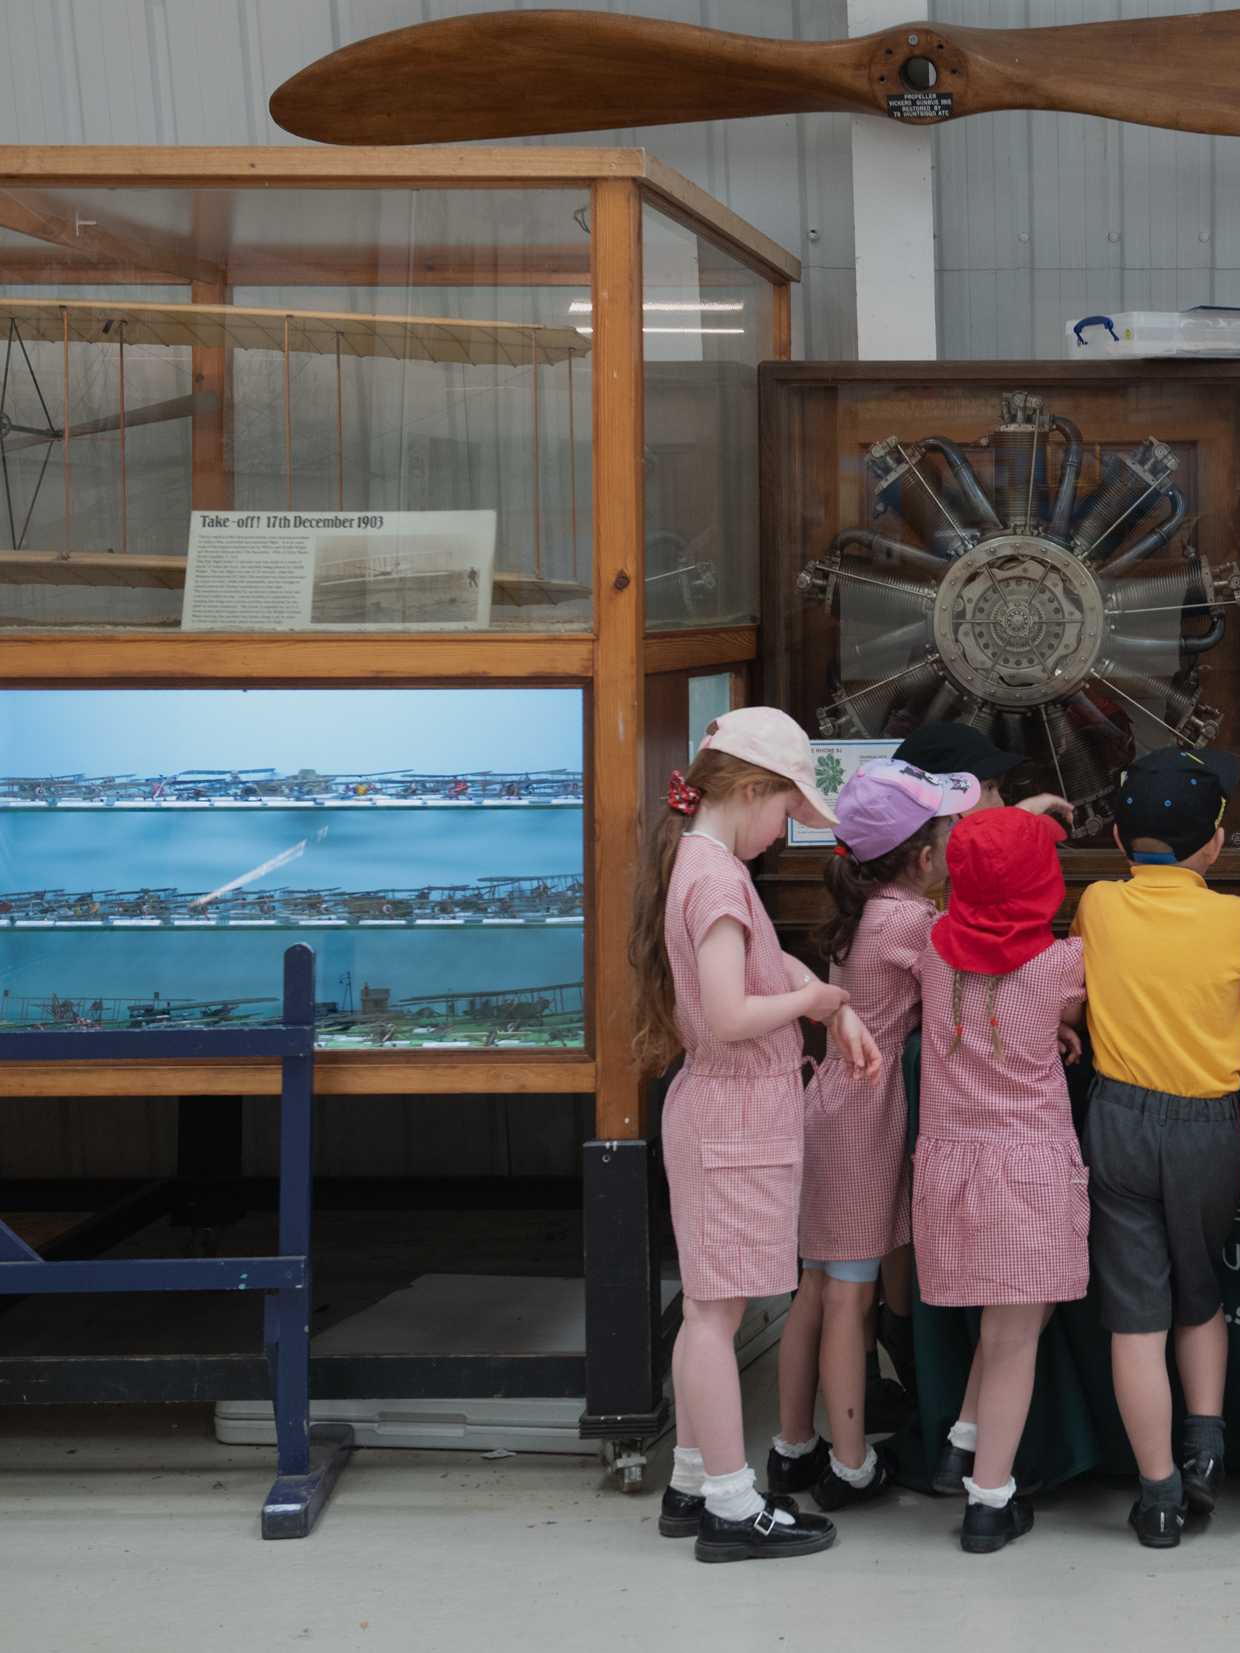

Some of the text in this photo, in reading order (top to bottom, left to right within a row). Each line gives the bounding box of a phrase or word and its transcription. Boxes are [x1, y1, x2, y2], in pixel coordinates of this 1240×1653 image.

[266, 515, 291, 528] 17th
[293, 515, 355, 529] December
[357, 515, 383, 530] 1903
